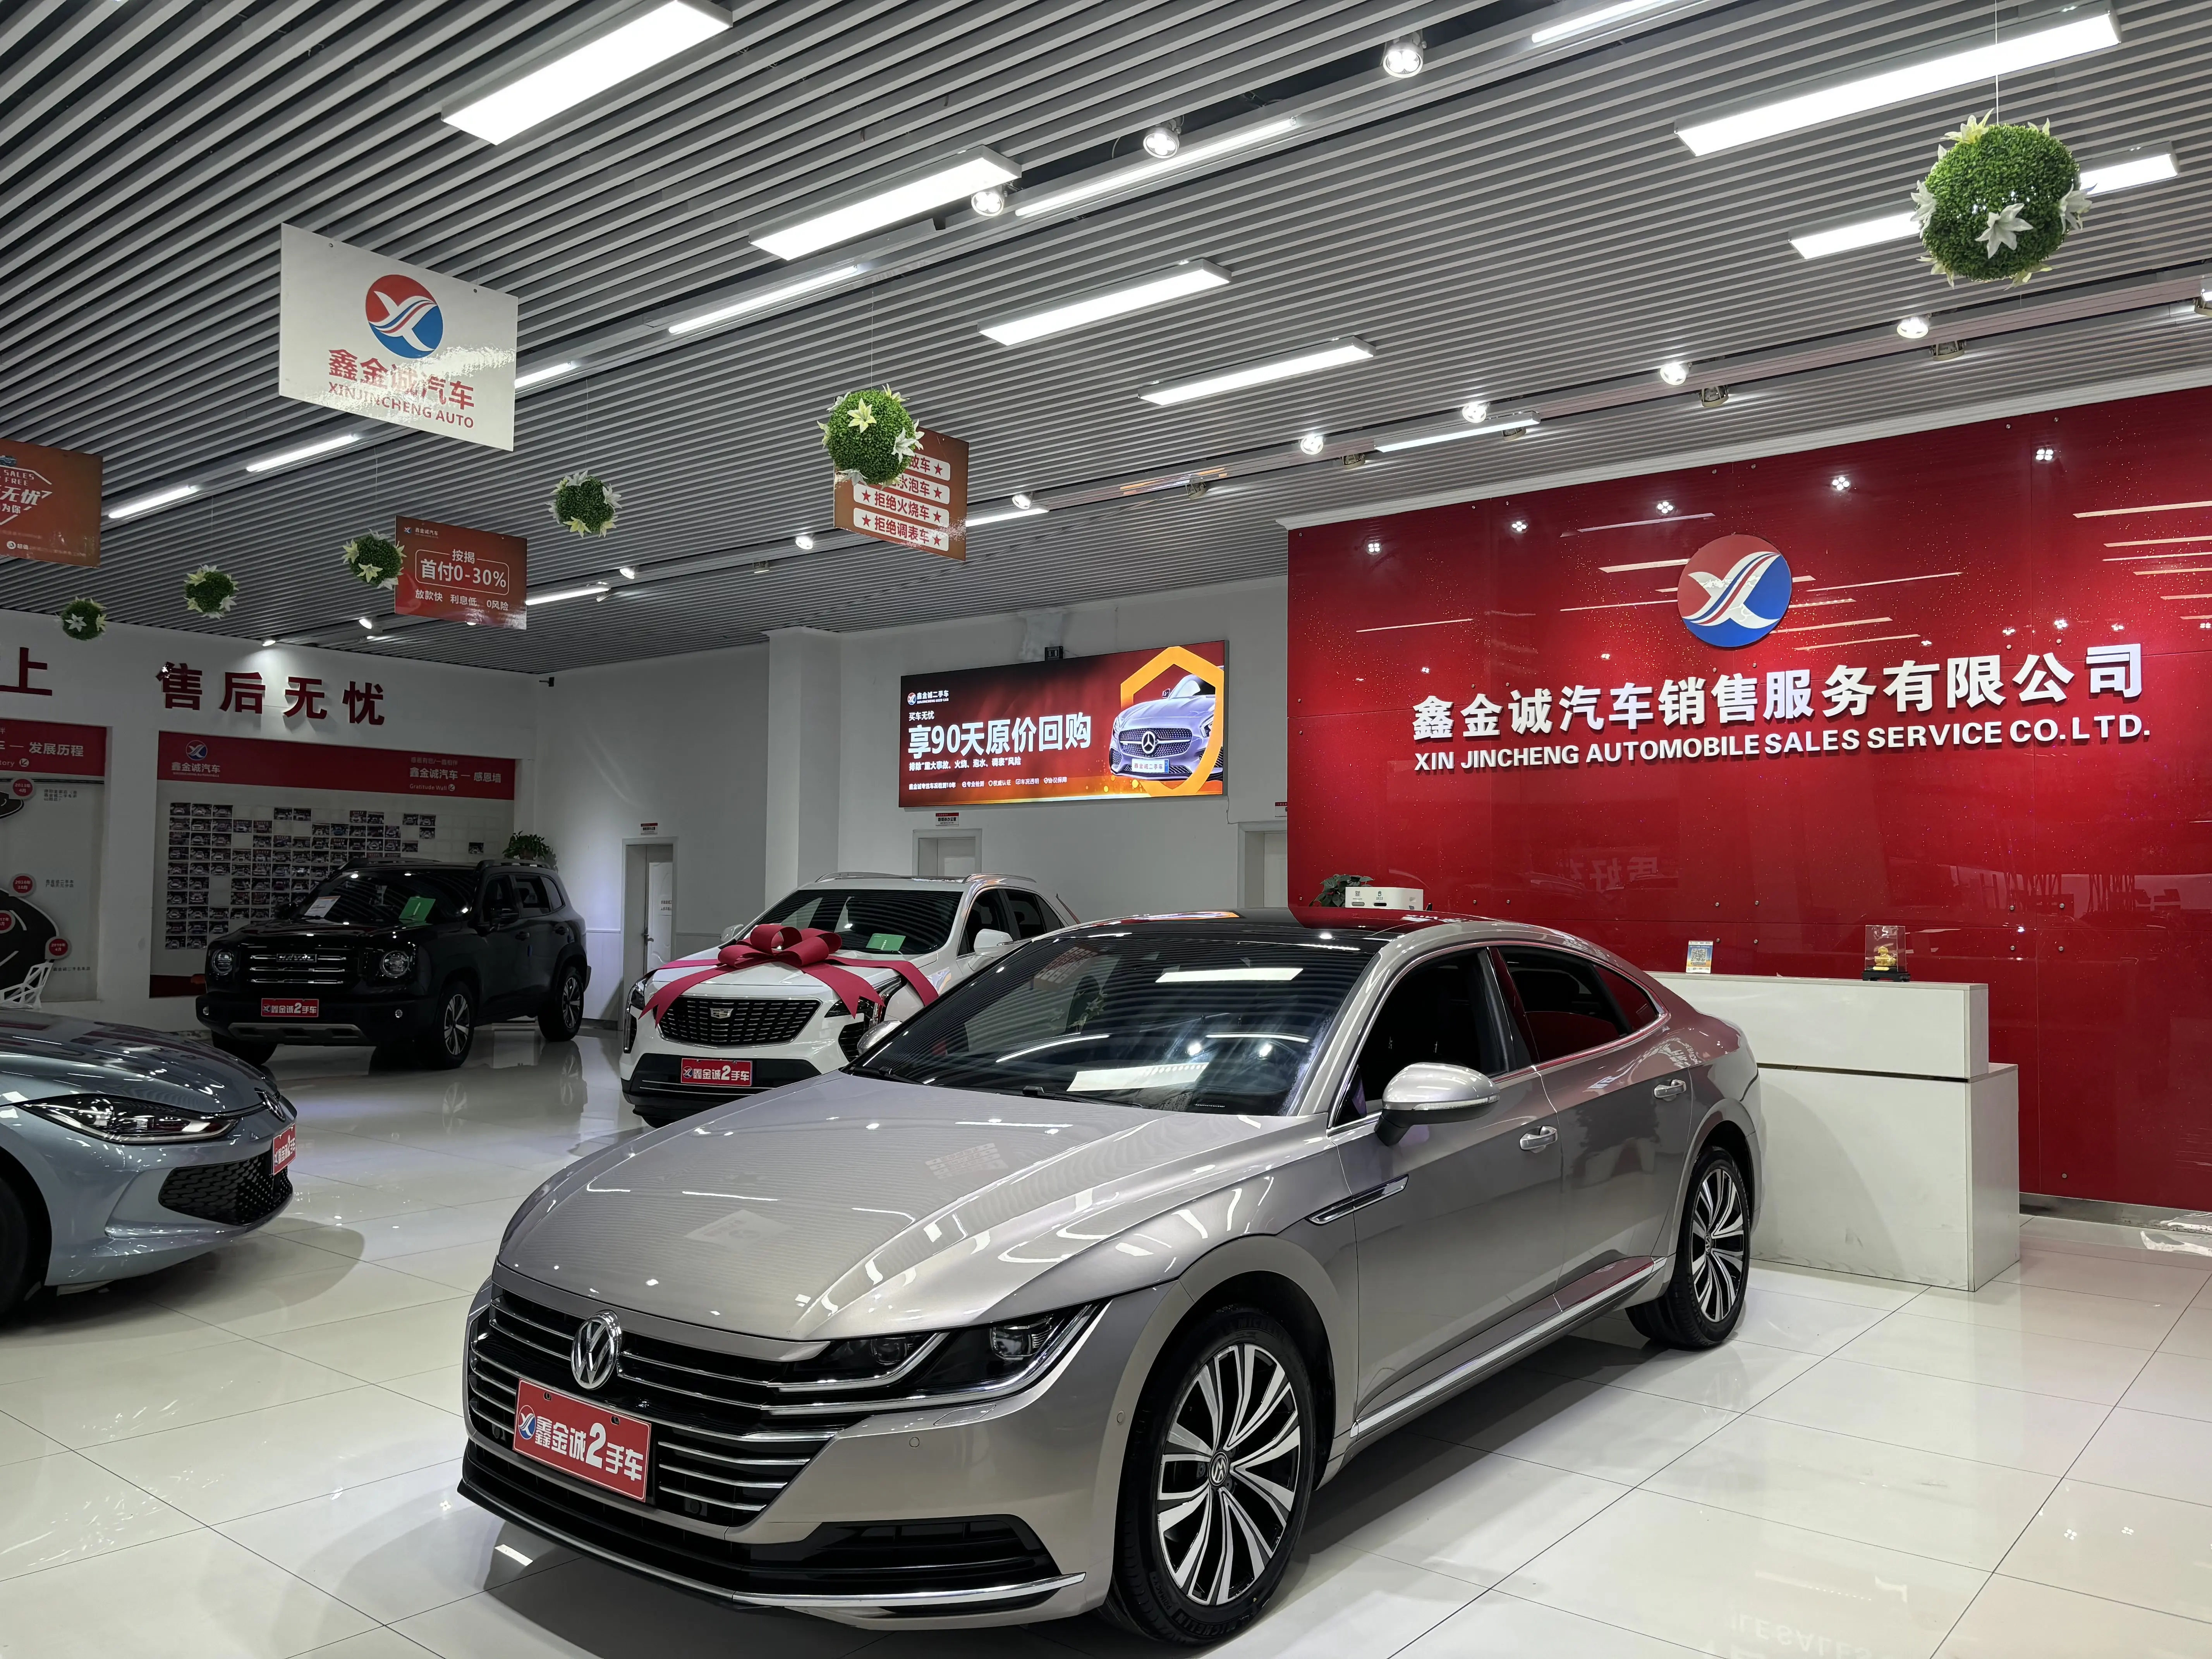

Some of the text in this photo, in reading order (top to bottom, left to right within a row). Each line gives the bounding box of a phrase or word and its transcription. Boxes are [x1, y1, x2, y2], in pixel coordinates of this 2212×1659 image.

[328, 348, 474, 410] 鑫金诚汽车
[435, 409, 474, 428] AUTO
[3, 469, 34, 480] SALES
[5, 477, 29, 486] FREE
[0, 485, 41, 505] 无忧
[874, 491, 930, 520] 拒绝火烧车
[874, 515, 930, 544] 拒绝调表车
[452, 549, 475, 564] 按揭
[421, 558, 507, 588] 首付0-30%
[415, 589, 508, 611] 放款快 利息低 0风险
[0, 647, 385, 725] 上 售后无忧
[917, 690, 949, 700] 鑫金诚二手车
[1412, 643, 2142, 741] 鑫金诚汽车销售服务有限公司
[908, 710, 935, 721] 买车无忧
[908, 712, 1091, 759] 享90天原价回购
[1414, 751, 1454, 771] XIN
[1461, 744, 1579, 769] JINCHENG
[1586, 733, 1760, 763] AUTOMOBILE
[1764, 729, 1860, 754] SALES
[1867, 720, 2002, 749] SERVICE
[29, 741, 84, 757] 发展历程
[171, 761, 221, 773] 鑫金诚汽车
[271, 1002, 317, 1014] 鑫金诚2手车
[693, 1065, 750, 1081] 鑫金诚2手车
[534, 1415, 644, 1482] 鑫金诚2手车
